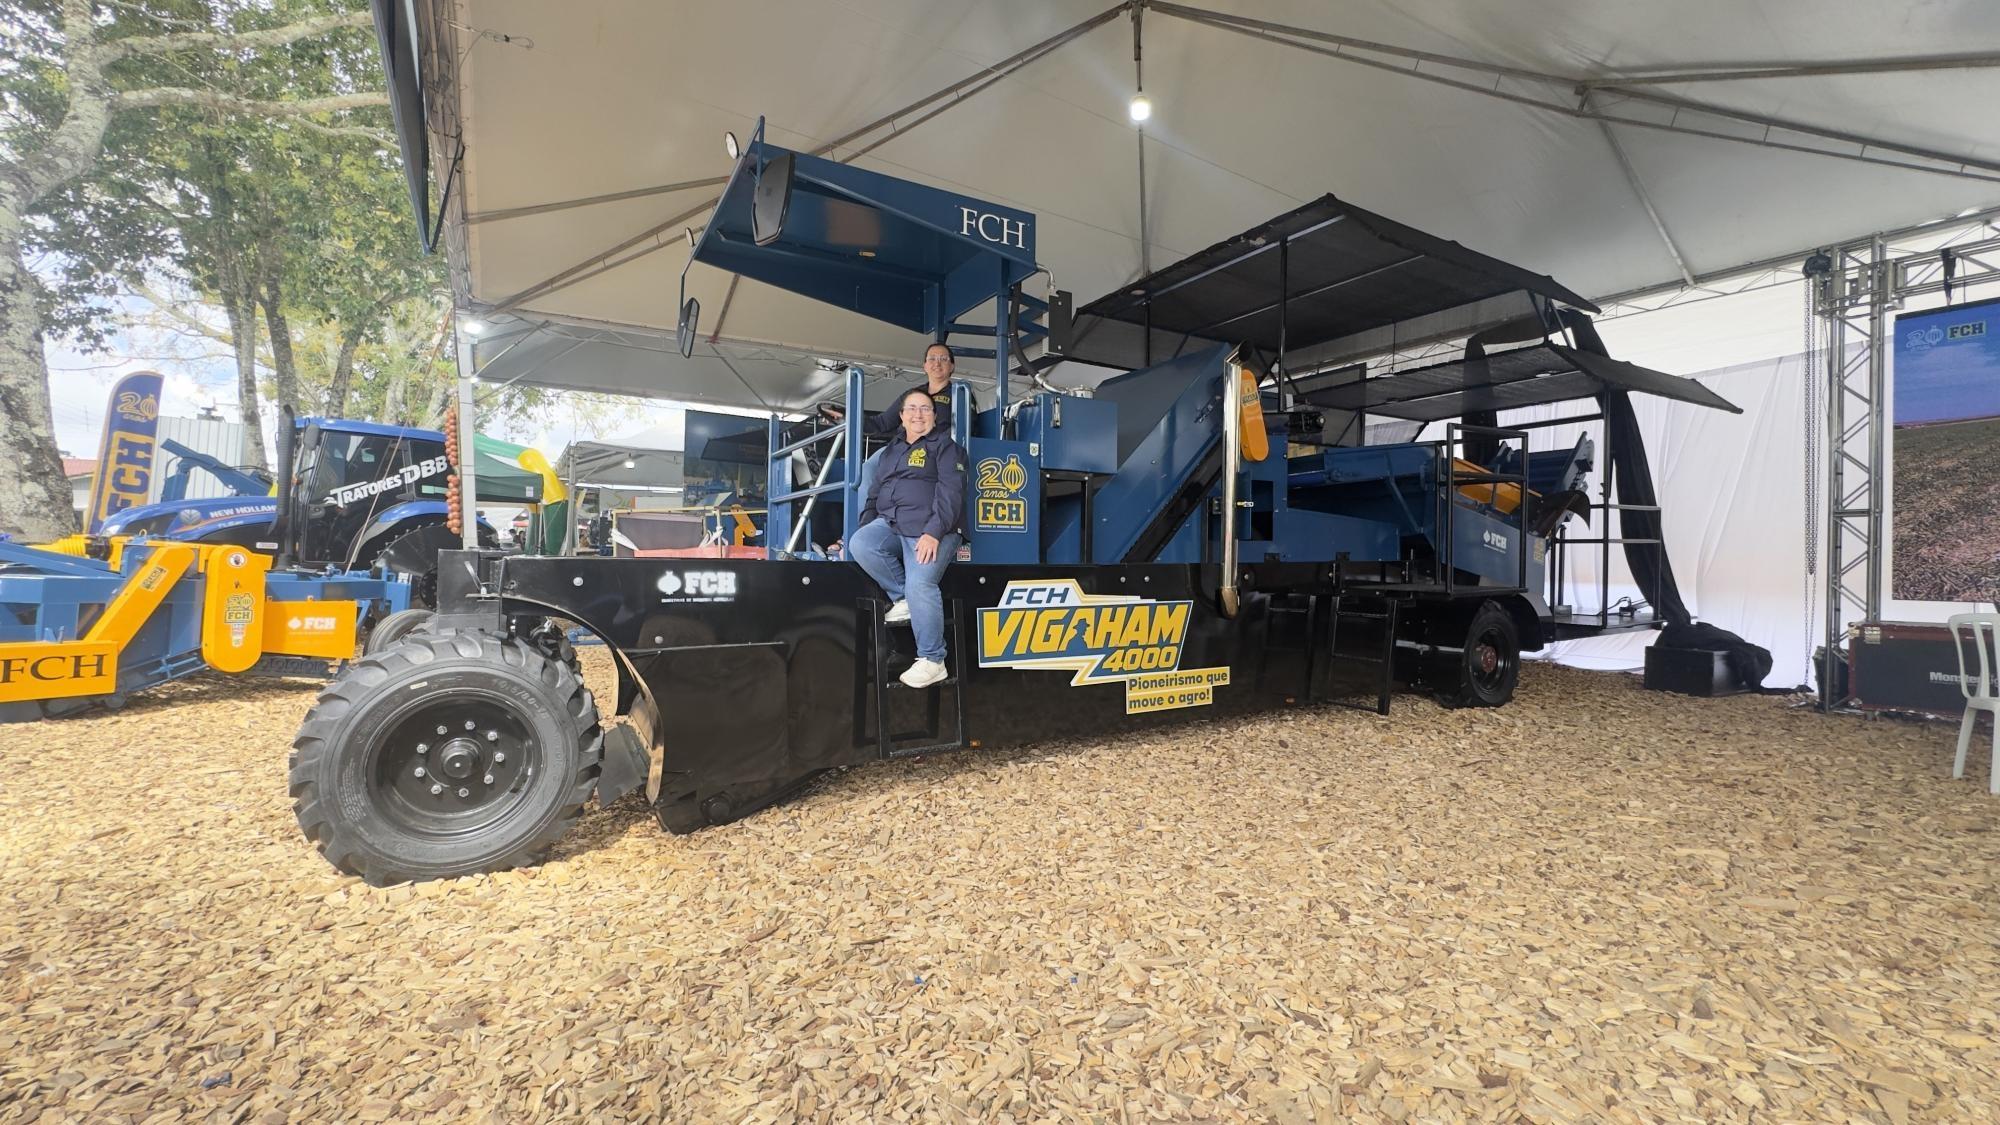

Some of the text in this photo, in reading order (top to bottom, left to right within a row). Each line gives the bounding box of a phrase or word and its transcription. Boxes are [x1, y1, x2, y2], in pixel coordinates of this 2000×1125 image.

[960, 207, 1025, 249] FCH
[1948, 322, 1984, 339] FCH
[324, 455, 448, 508] TRATORES DBB
[983, 489, 1009, 498] anos
[209, 504, 277, 518] NEW HOLLAN
[981, 502, 1021, 521] FCH
[1491, 532, 1507, 549] FCH
[684, 572, 736, 594] FCH
[1005, 587, 1070, 605] FCH
[228, 611, 250, 620] FCH
[304, 617, 336, 630] FCH
[983, 604, 1188, 657] VIGAHAM
[1102, 646, 1178, 672] 4000
[0, 654, 108, 683] FCH
[1128, 672, 1228, 690] Pioneirismo que
[1129, 689, 1210, 709] move o agro!
